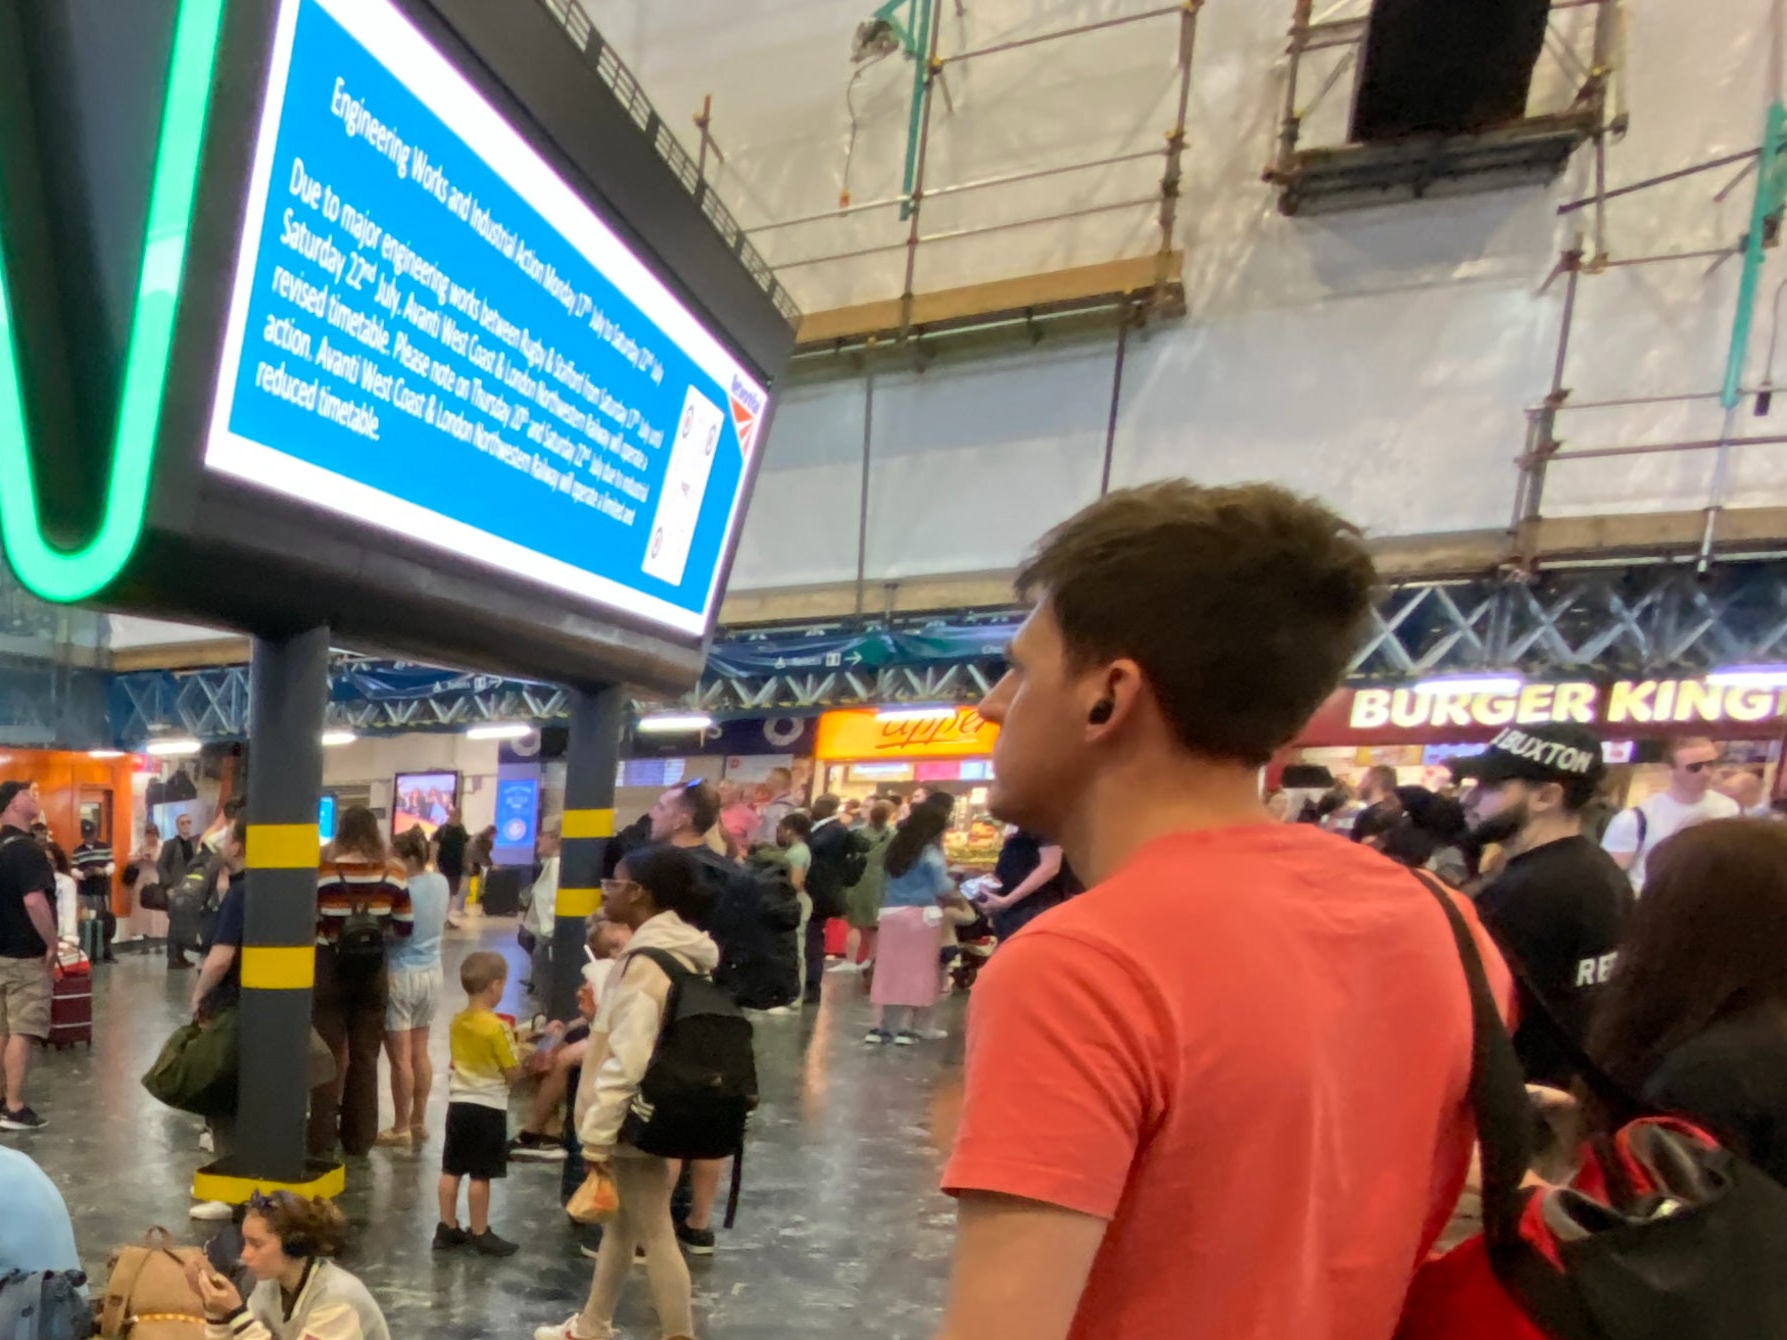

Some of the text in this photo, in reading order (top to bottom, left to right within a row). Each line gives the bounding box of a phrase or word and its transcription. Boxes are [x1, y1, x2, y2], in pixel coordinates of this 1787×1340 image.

[290, 157, 322, 210] Due
[323, 185, 341, 222] to
[341, 204, 381, 250] major
[382, 233, 450, 306] engineering
[448, 282, 481, 321] works
[479, 300, 521, 349] between
[332, 77, 412, 179] Engineering
[412, 146, 448, 203] Works
[447, 186, 472, 222] and
[470, 200, 517, 259] Industrial
[514, 240, 545, 284] Action
[543, 264, 578, 315] Monday
[273, 266, 328, 318] revised
[327, 294, 389, 355] timetable.
[393, 331, 431, 378] Please
[430, 360, 456, 392] note
[454, 376, 470, 400] on
[470, 377, 512, 427] Thursday
[509, 404, 529, 431] 20th
[281, 208, 345, 284] Saturday
[346, 251, 377, 291] 22nd
[375, 273, 401, 318] July.
[403, 292, 441, 339] Avanti
[440, 315, 470, 357] West
[468, 334, 496, 374] Coast
[494, 351, 505, 380] &
[503, 362, 537, 400] London
[256, 361, 379, 441] reduced timetable.
[264, 314, 312, 361] action.
[316, 336, 362, 384] Avanti
[360, 358, 394, 402] West
[392, 377, 426, 419] Coast
[424, 394, 437, 425] &
[435, 403, 475, 443] London
[473, 422, 532, 473] Northwestern
[1350, 679, 1778, 729] BURGER KING
